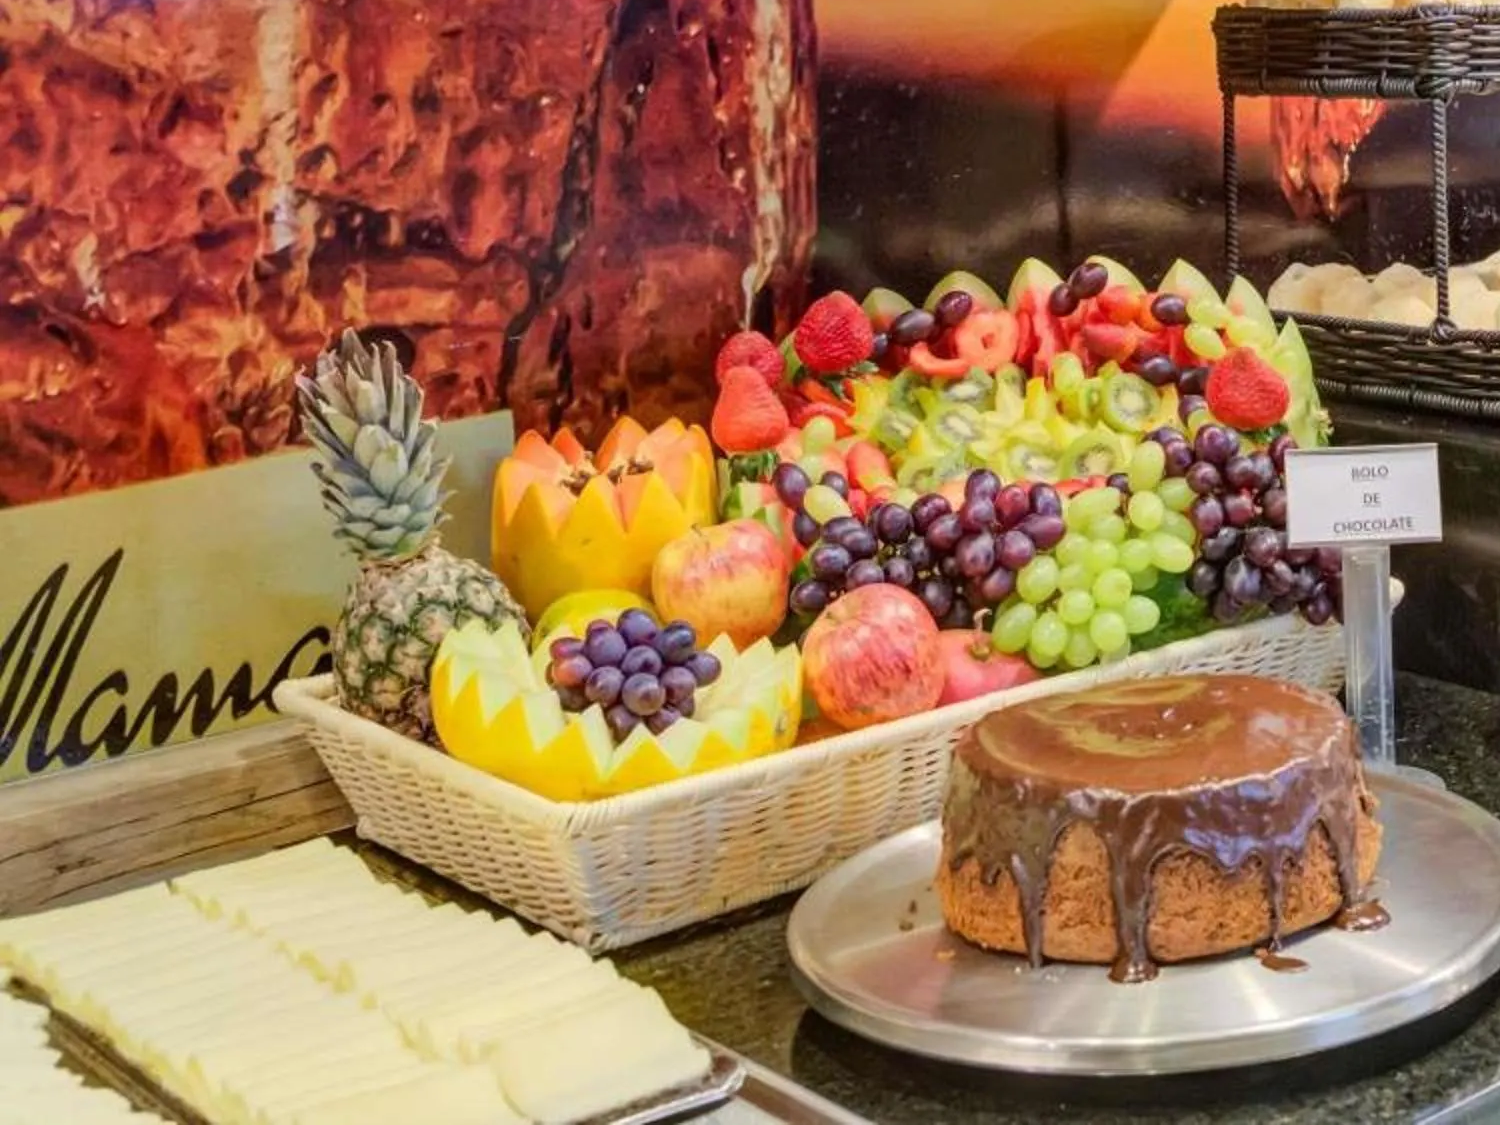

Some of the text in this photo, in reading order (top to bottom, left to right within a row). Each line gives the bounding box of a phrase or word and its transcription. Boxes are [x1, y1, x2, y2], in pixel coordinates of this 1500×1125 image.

[1351, 465, 1390, 480] BOLO
[1363, 492, 1382, 505] DE
[1333, 516, 1414, 534] CHOCOLATE
